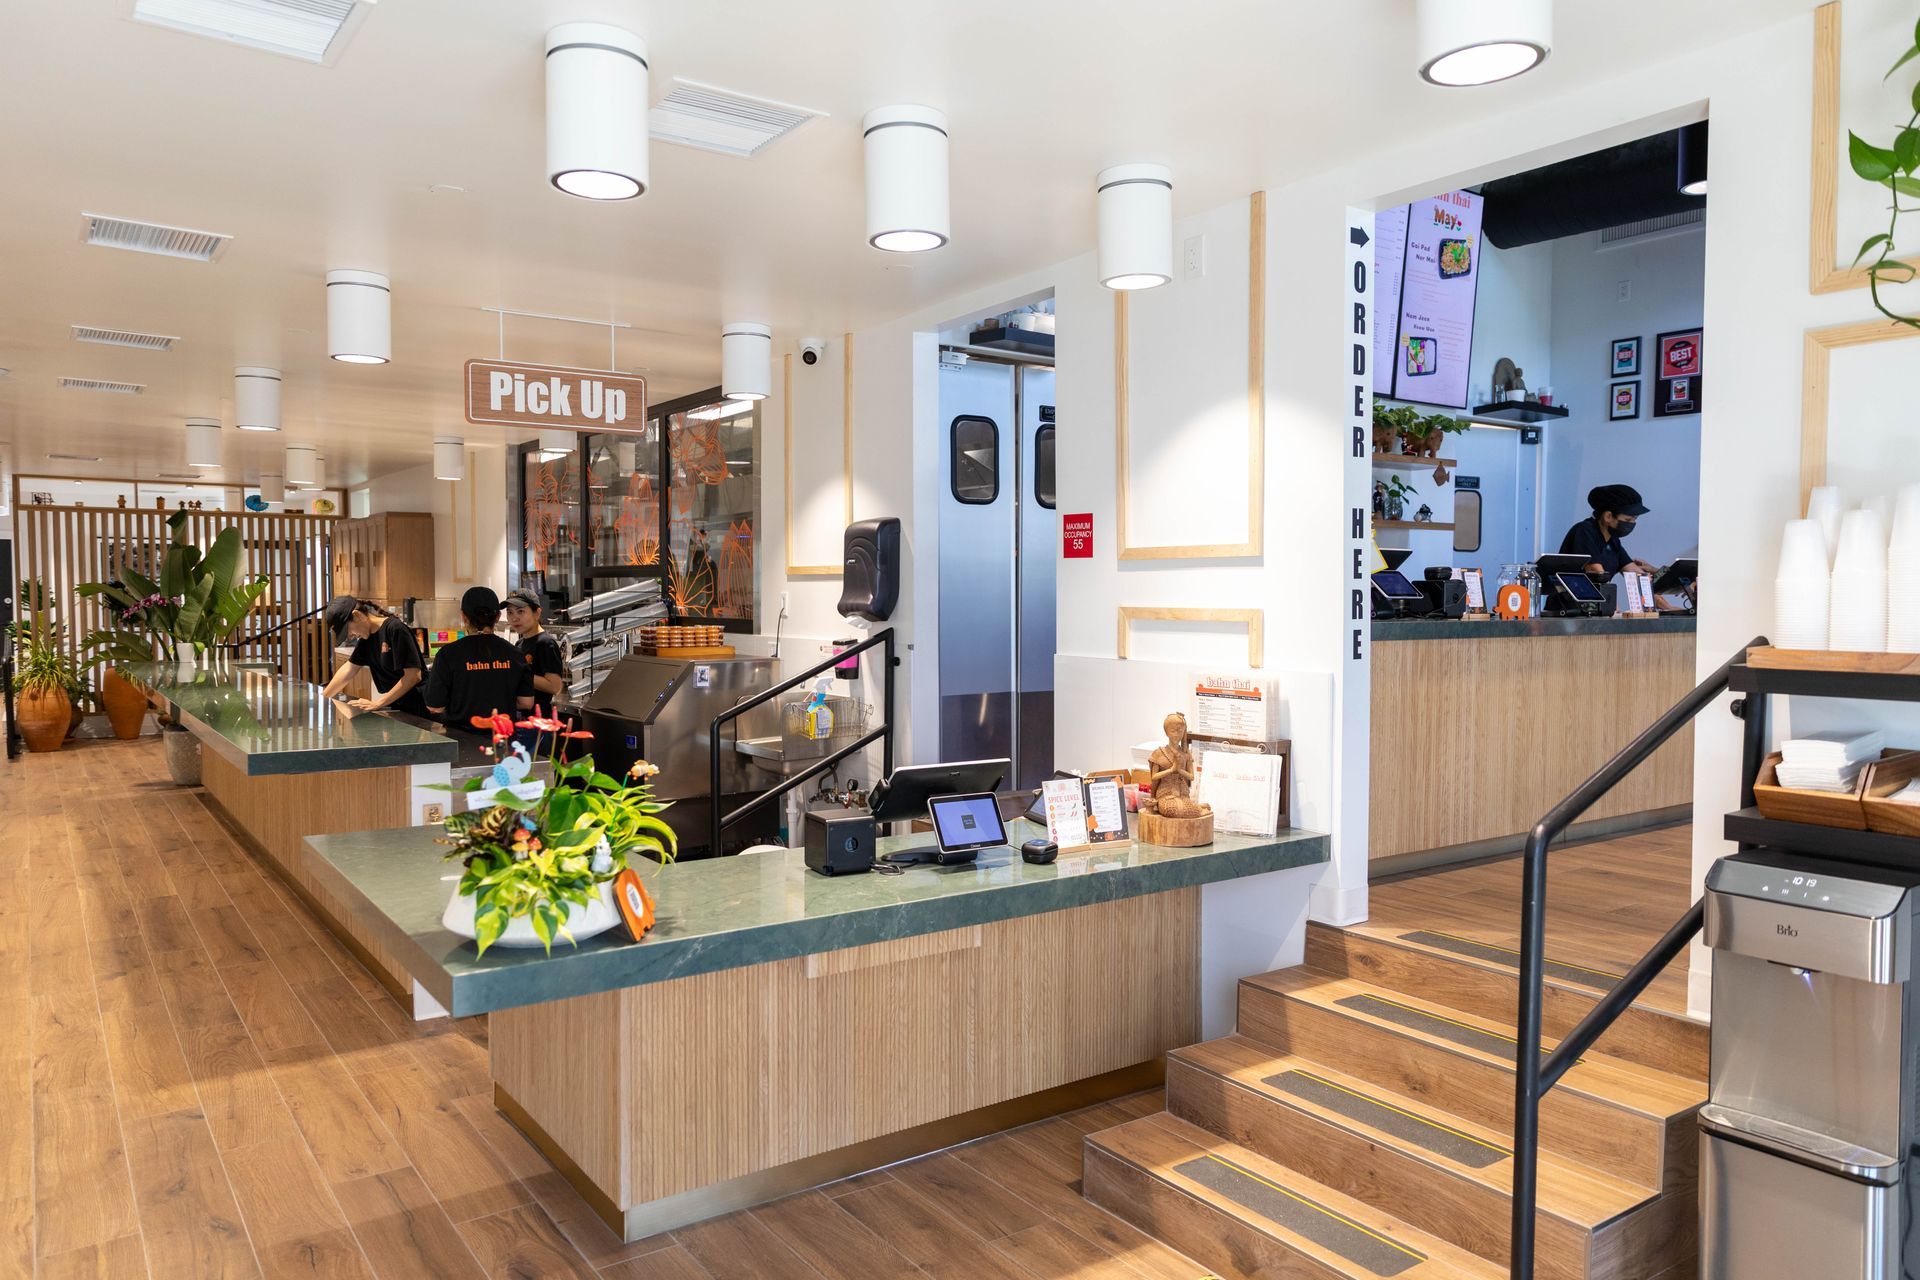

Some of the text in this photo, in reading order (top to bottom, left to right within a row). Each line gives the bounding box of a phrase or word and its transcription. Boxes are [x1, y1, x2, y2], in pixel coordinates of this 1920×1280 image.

[1434, 208, 1457, 230] May
[1618, 351, 1631, 359] BEST
[1670, 346, 1692, 362] BEST
[490, 371, 627, 424] Pick Up
[1351, 260, 1366, 660] ORDER HERE
[1066, 522, 1090, 530] MAXIMUM
[1064, 530, 1092, 539] OCCUPANCY
[1073, 539, 1083, 549] 55
[466, 660, 510, 670] bahn thai
[1206, 677, 1250, 690] bahn thai
[1048, 793, 1080, 803] SPICE LEVEL
[1777, 924, 1798, 937] Brio
